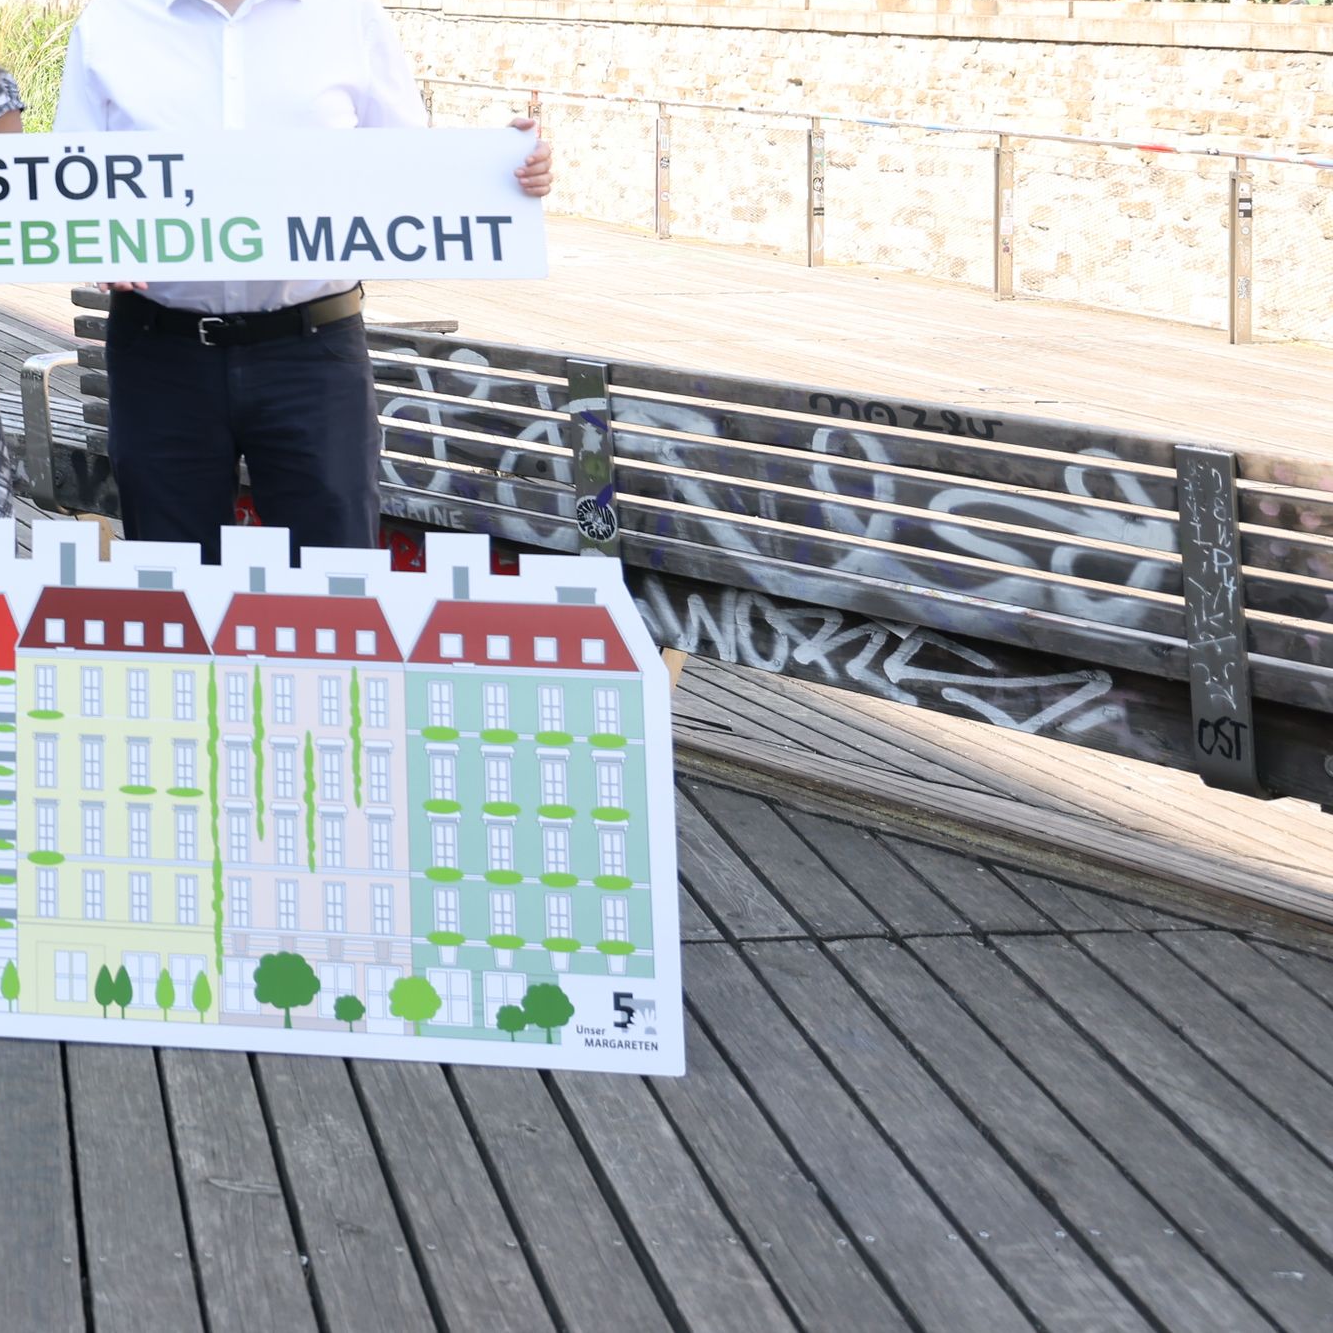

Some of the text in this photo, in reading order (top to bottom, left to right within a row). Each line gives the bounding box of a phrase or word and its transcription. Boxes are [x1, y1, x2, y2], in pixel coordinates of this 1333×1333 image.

[286, 214, 514, 263] MACHT
[576, 1025, 606, 1035] Unser
[584, 1037, 659, 1051] MARGARETEN
